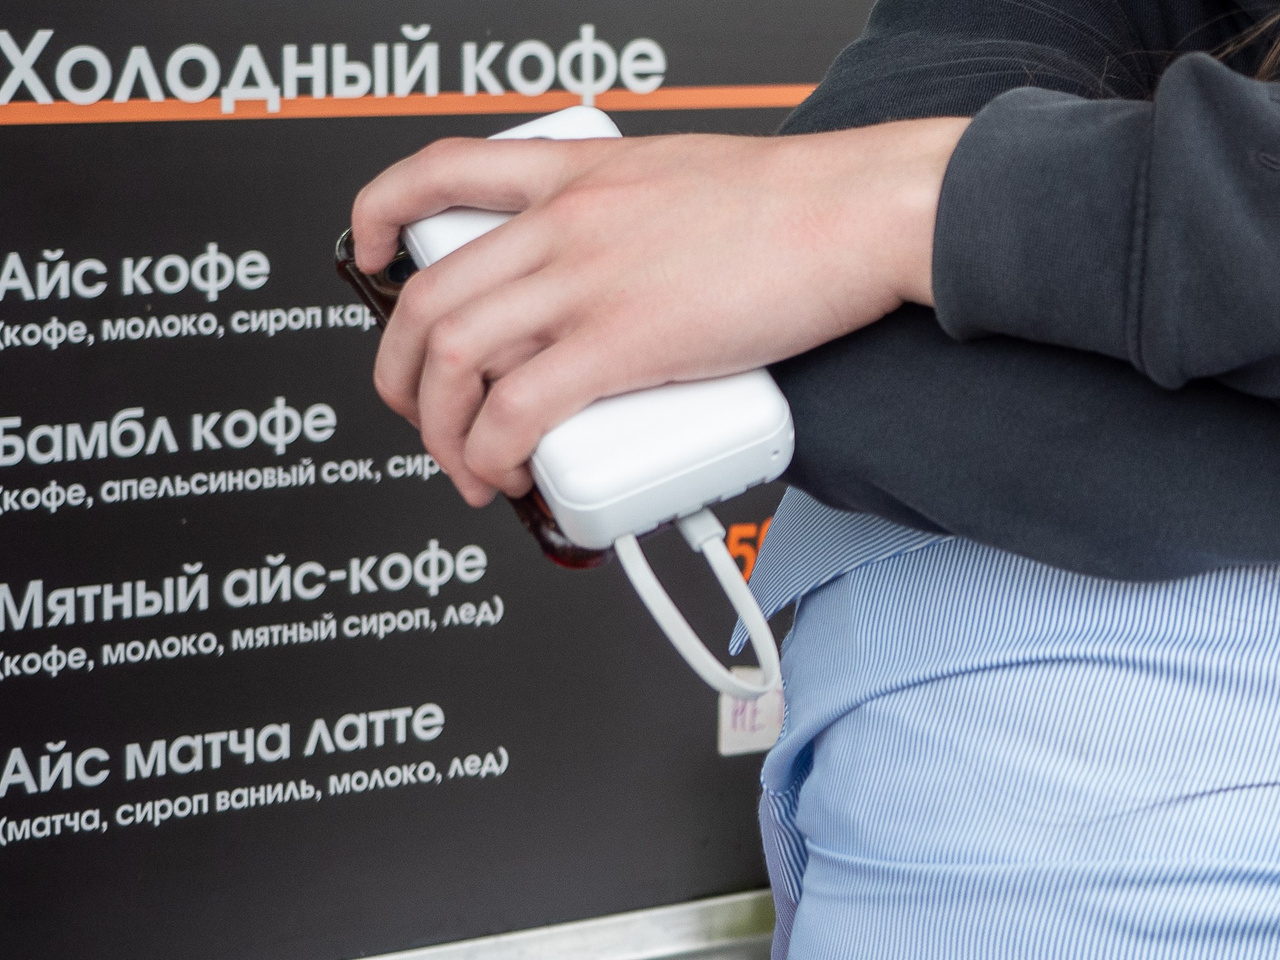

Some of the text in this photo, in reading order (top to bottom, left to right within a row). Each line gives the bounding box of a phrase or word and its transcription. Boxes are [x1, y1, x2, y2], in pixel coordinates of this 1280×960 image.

[0, 23, 668, 114] Холодный кофе
[0, 242, 271, 303] Айс кофе
[102, 311, 225, 341] молоко,
[230, 306, 322, 338] сироп
[0, 396, 338, 467] Бамбл кофе
[100, 457, 316, 503] апельсиновый
[321, 458, 382, 484] сок,
[0, 539, 488, 632] Мятный айс-кофе
[727, 515, 774, 585] 5
[101, 631, 225, 667] молоко,
[231, 612, 337, 651] мятный
[342, 606, 438, 639] сироп,
[443, 594, 505, 626] лед)
[0, 701, 446, 798] Айс матча латте
[0, 745, 510, 845] (матча, сироп ваниль, молоко, лед)
